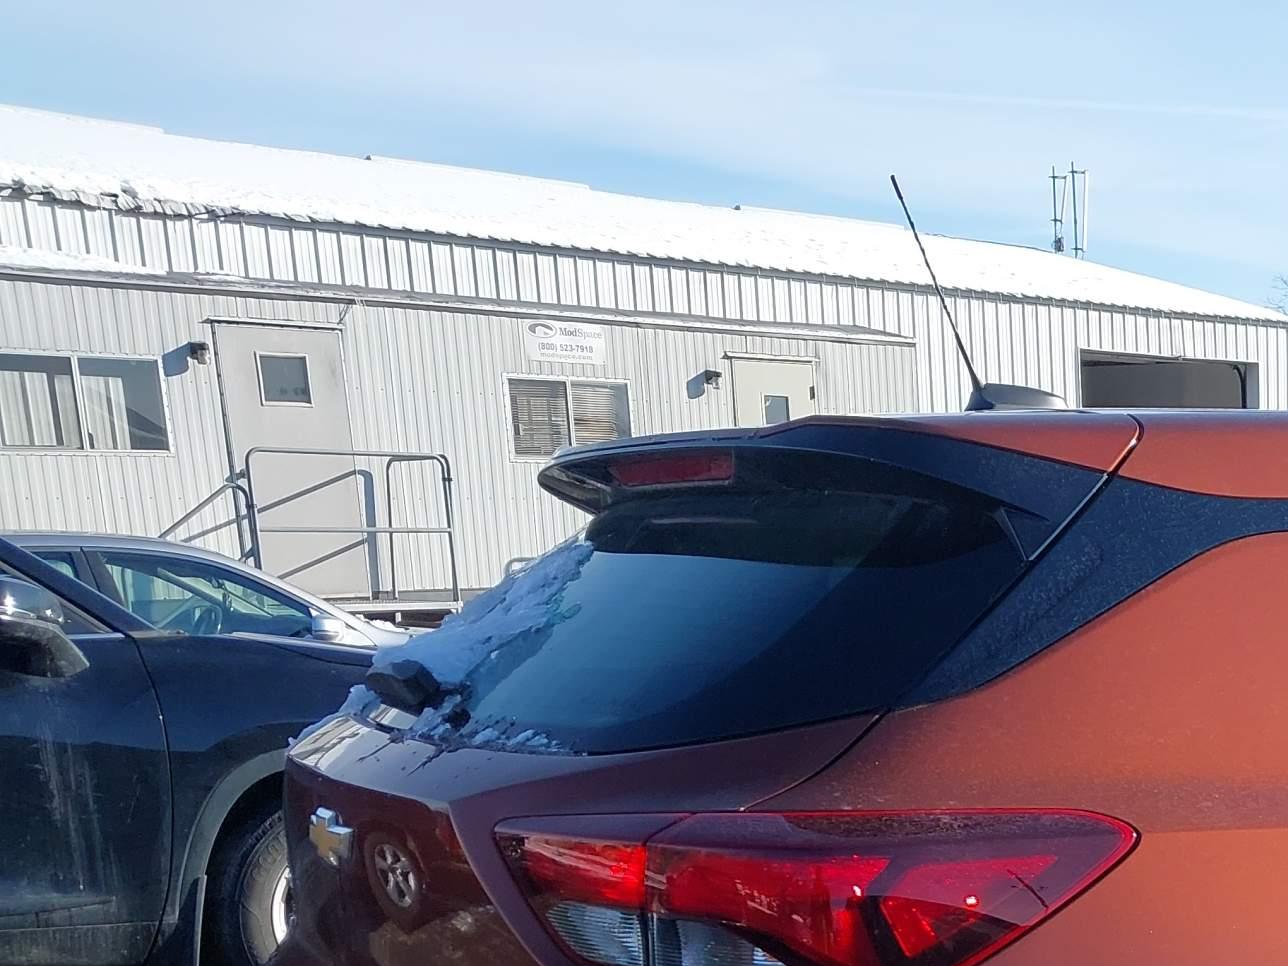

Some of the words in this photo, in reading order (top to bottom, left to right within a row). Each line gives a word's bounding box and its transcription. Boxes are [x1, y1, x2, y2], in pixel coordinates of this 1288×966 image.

[559, 326, 603, 340] ModSpace
[538, 342, 558, 353] (800)
[560, 343, 594, 354] 523-7918
